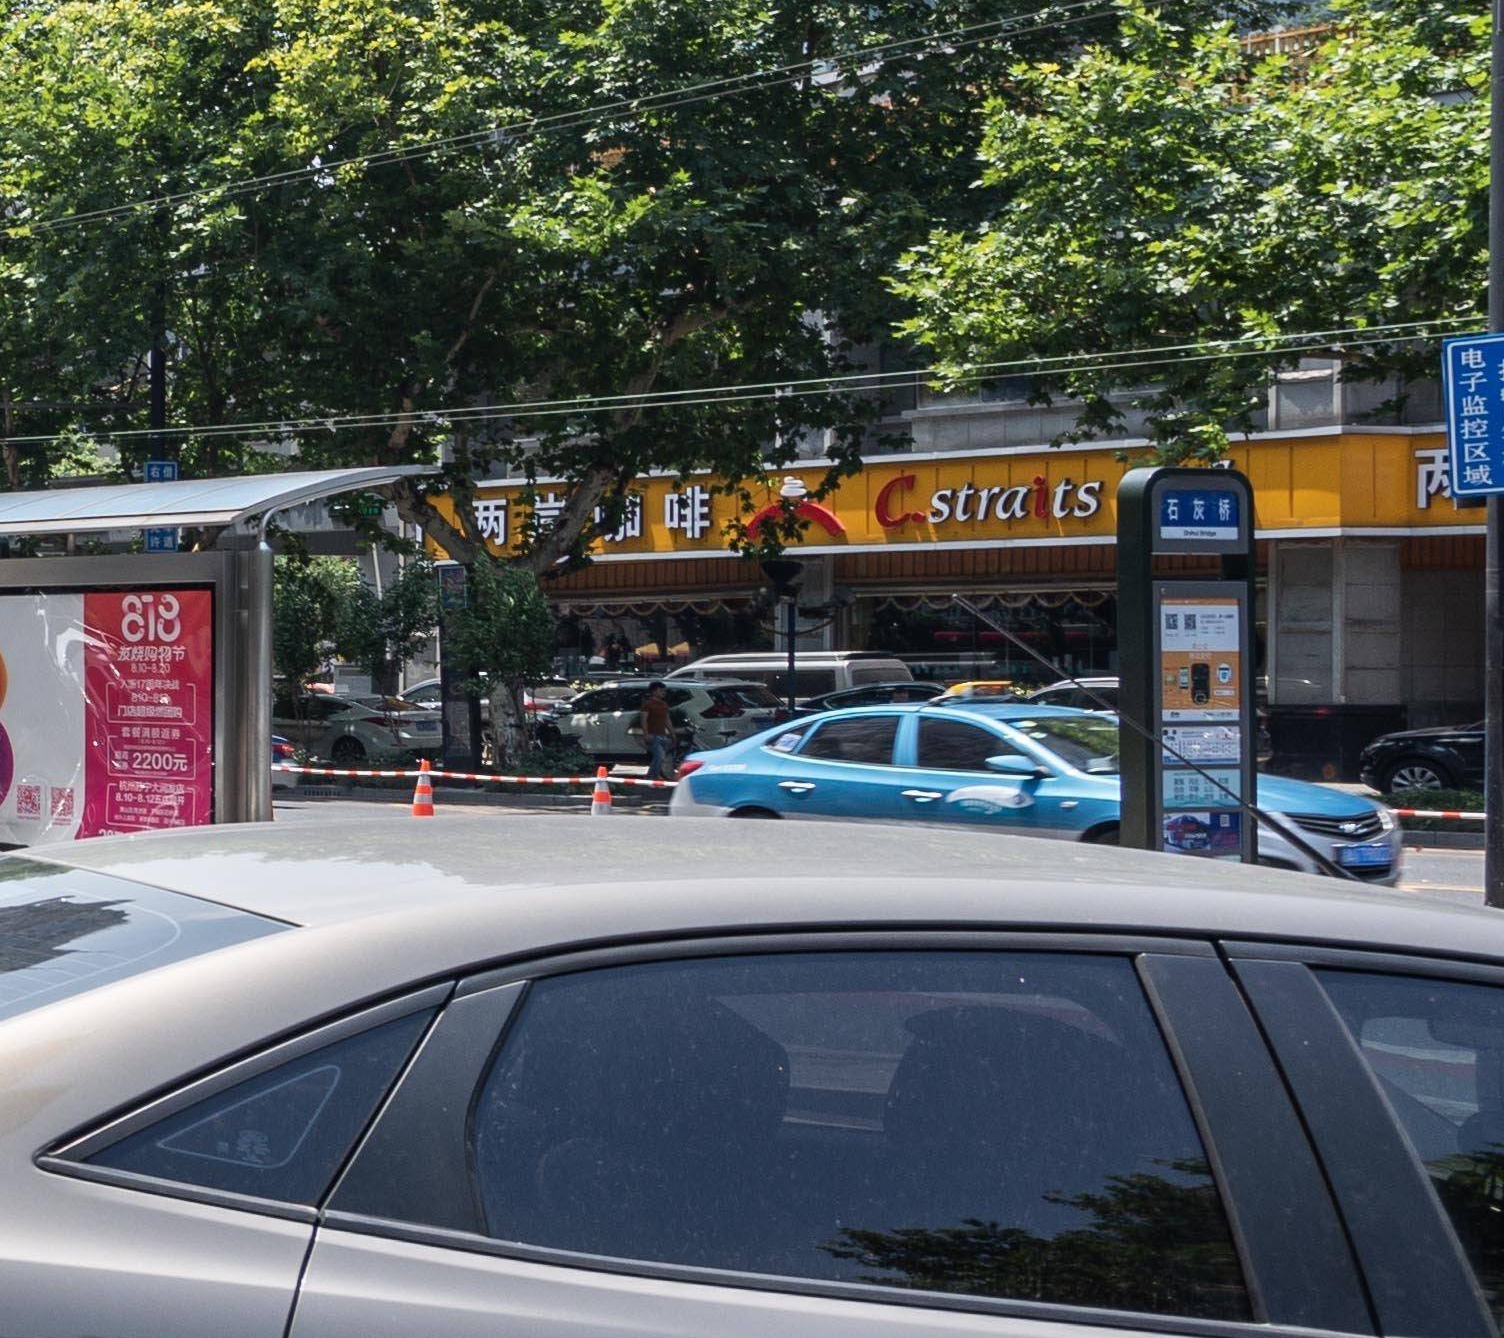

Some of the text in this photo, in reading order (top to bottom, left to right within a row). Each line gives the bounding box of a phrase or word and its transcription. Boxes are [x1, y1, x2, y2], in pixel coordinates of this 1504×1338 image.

[1458, 347, 1493, 486] 电子监控区域
[1166, 498, 1232, 522] 石灰桥
[120, 593, 182, 643] 818
[132, 752, 188, 772] 2200元
